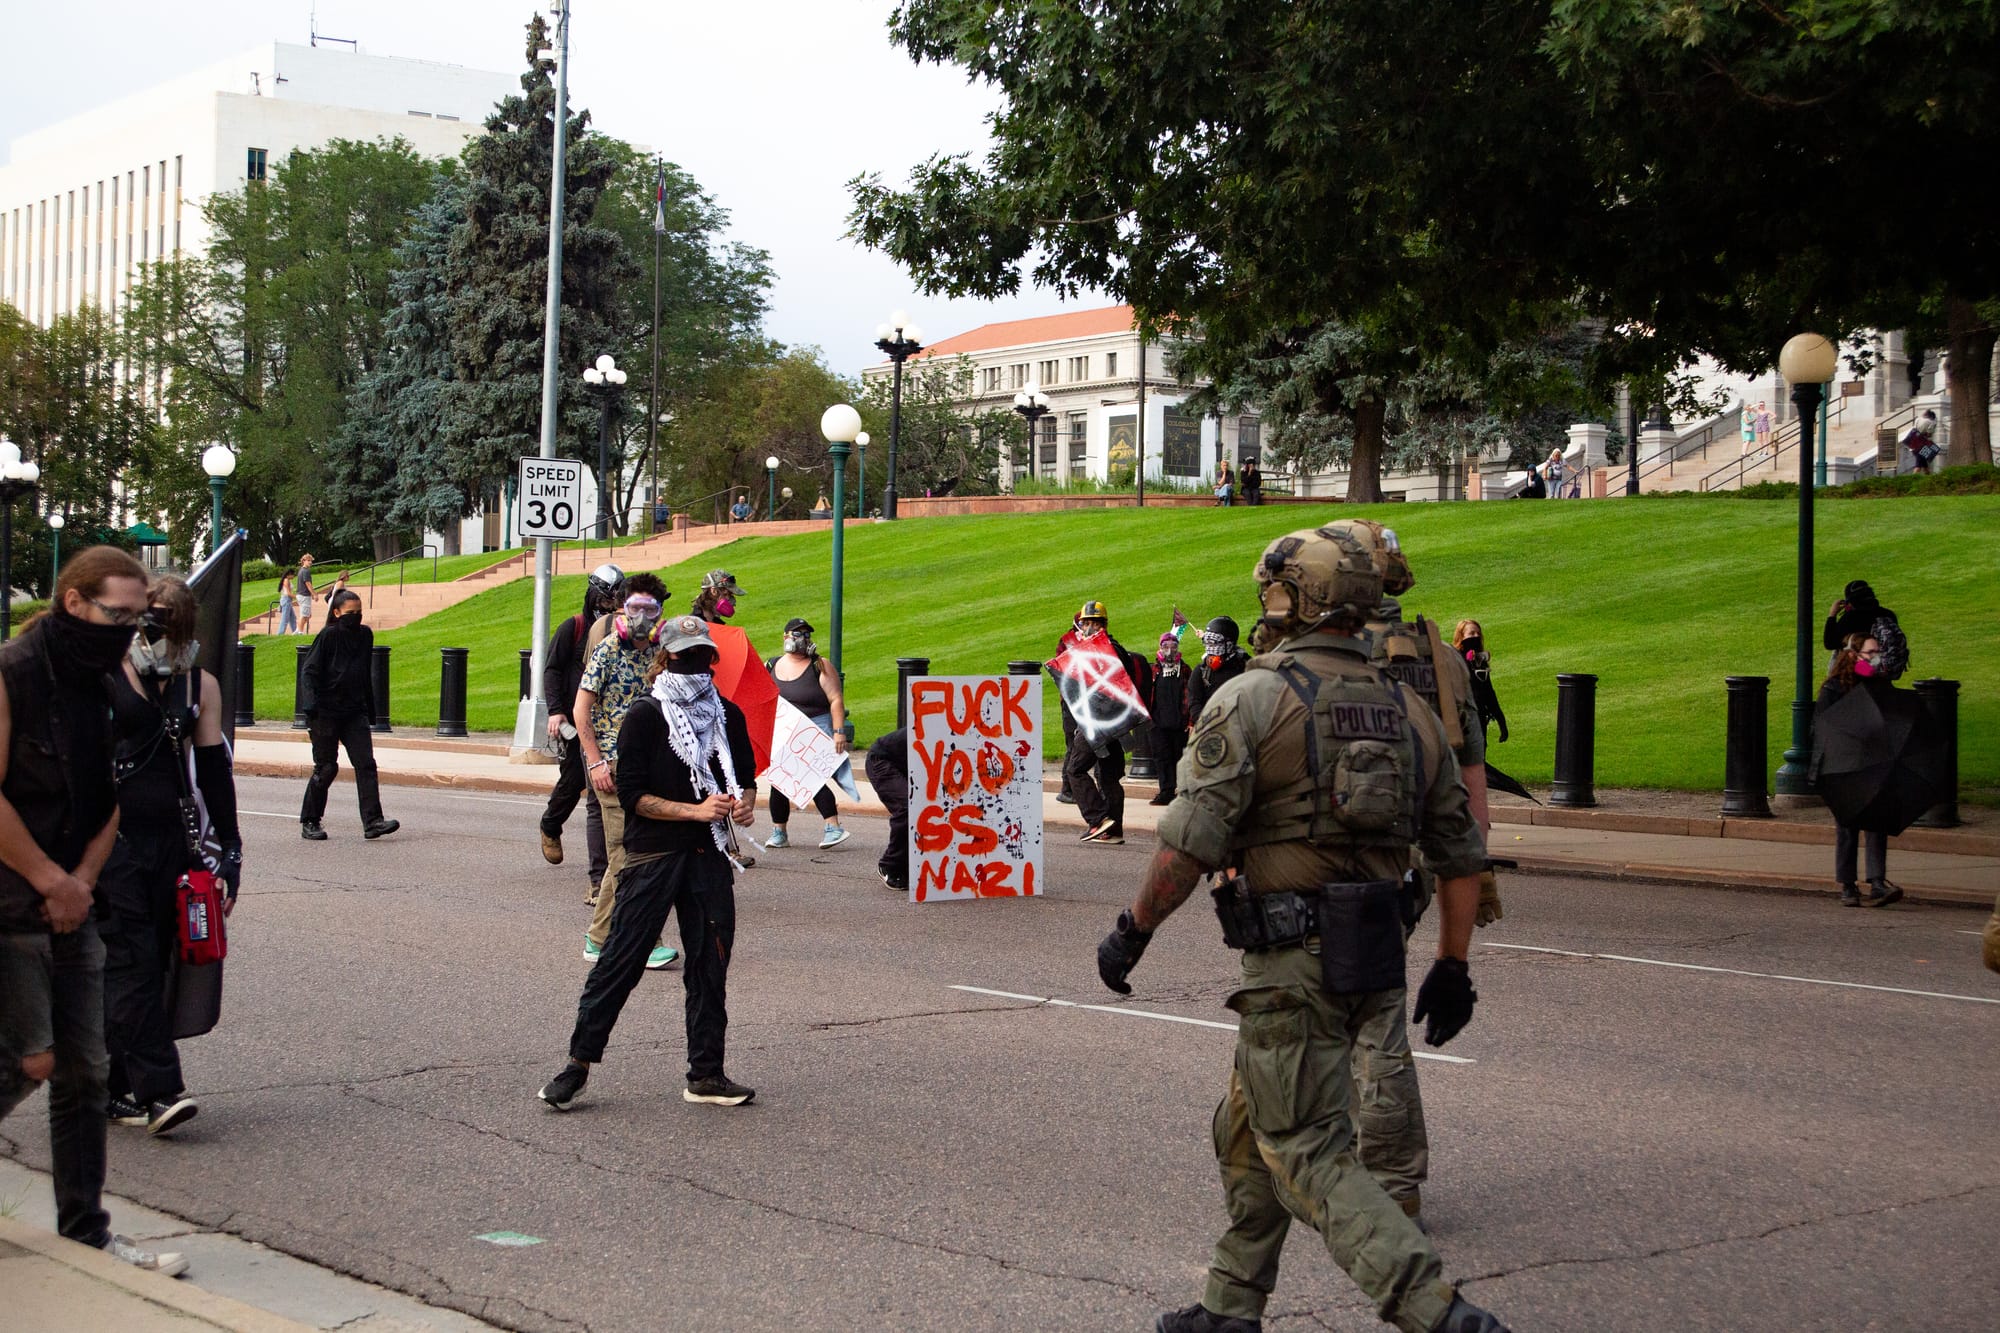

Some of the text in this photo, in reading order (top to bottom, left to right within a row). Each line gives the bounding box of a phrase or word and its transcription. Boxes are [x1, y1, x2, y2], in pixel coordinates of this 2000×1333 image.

[1167, 420, 1198, 428] COLORADO
[526, 466, 576, 481] SPEED
[530, 483, 570, 498] LIMIT
[525, 500, 573, 531] 30
[912, 677, 1033, 740] FUCK
[1335, 706, 1398, 735] POLICE
[916, 804, 999, 855] SS
[915, 855, 1034, 902] NAZI
[200, 917, 208, 938] FIRST
